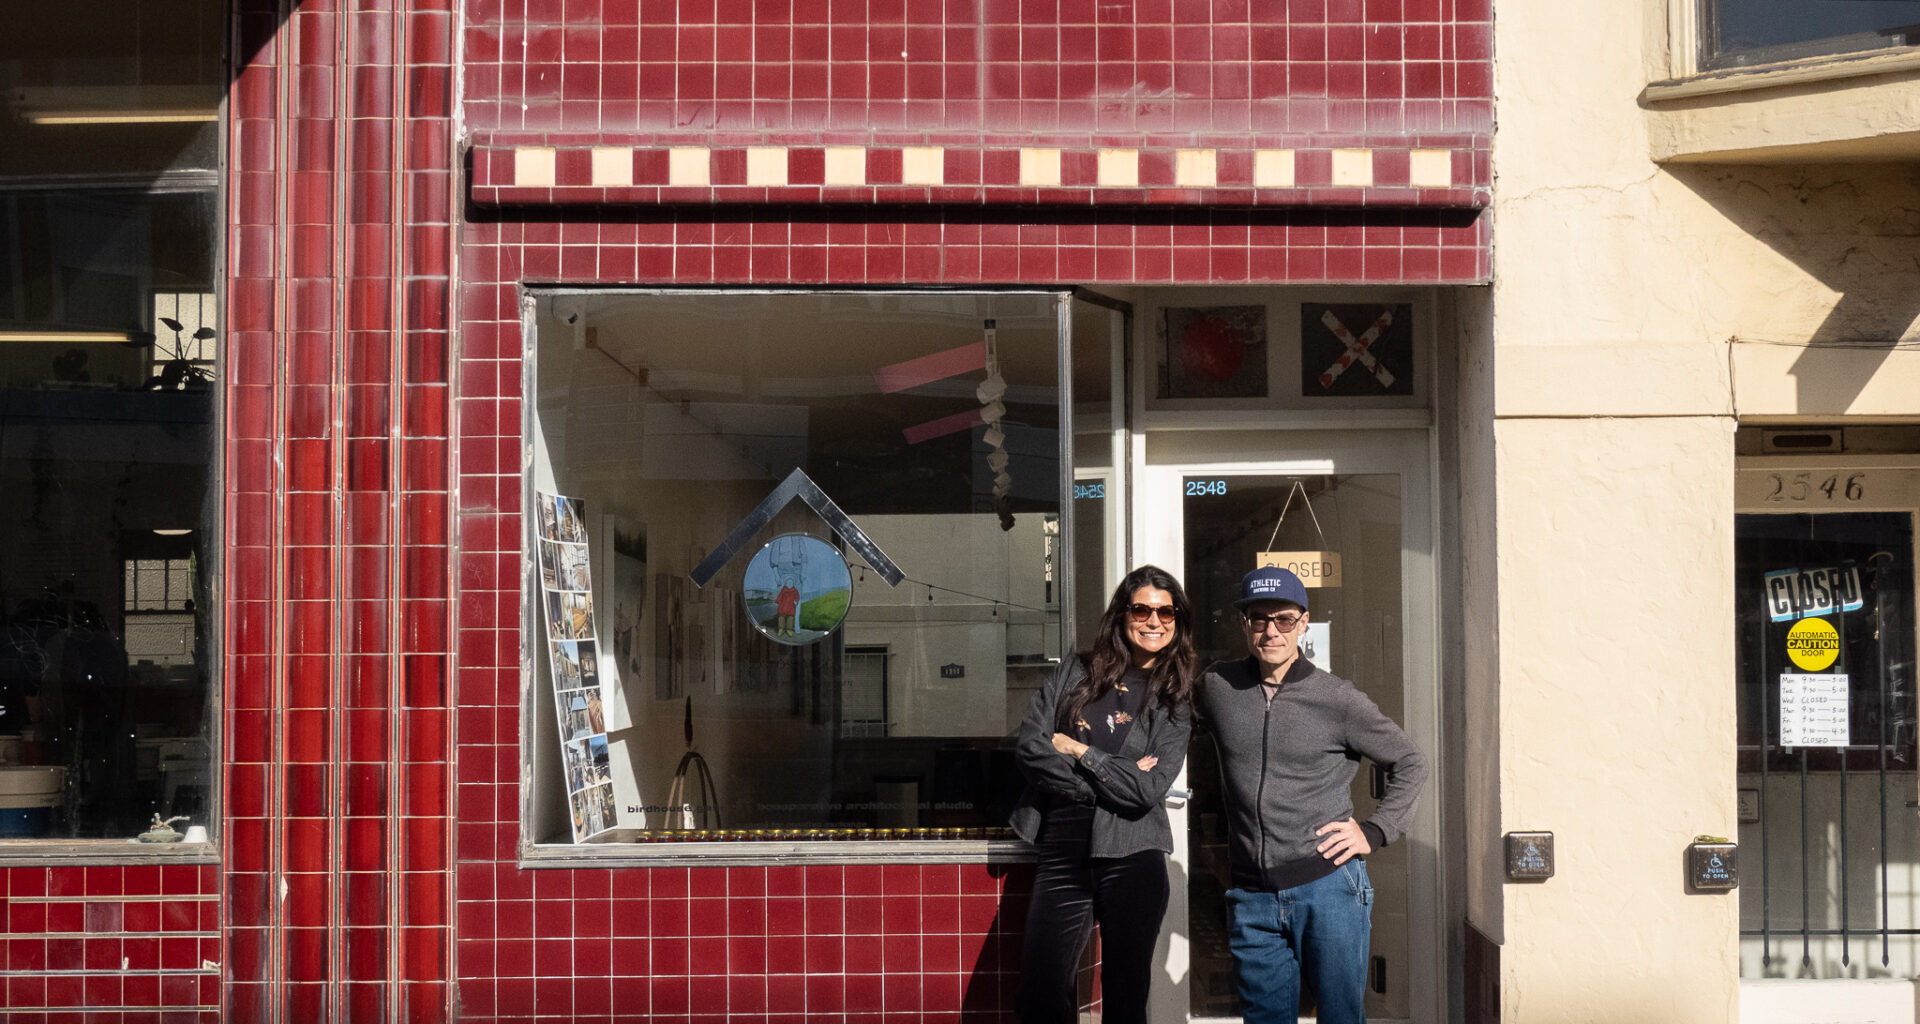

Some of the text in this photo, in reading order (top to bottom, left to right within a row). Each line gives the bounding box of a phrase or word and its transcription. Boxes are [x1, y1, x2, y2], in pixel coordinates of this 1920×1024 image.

[1186, 480, 1227, 496] 2548
[1764, 472, 1865, 501] 2546
[1266, 562, 1333, 578] OSED
[1250, 579, 1281, 588] ATHLETIC
[1770, 568, 1858, 615] CLOSED
[1787, 640, 1839, 649] CAUTION
[1801, 736, 1829, 744] CLOSED
[627, 805, 692, 813] birdhouse
[934, 801, 974, 811] studio
